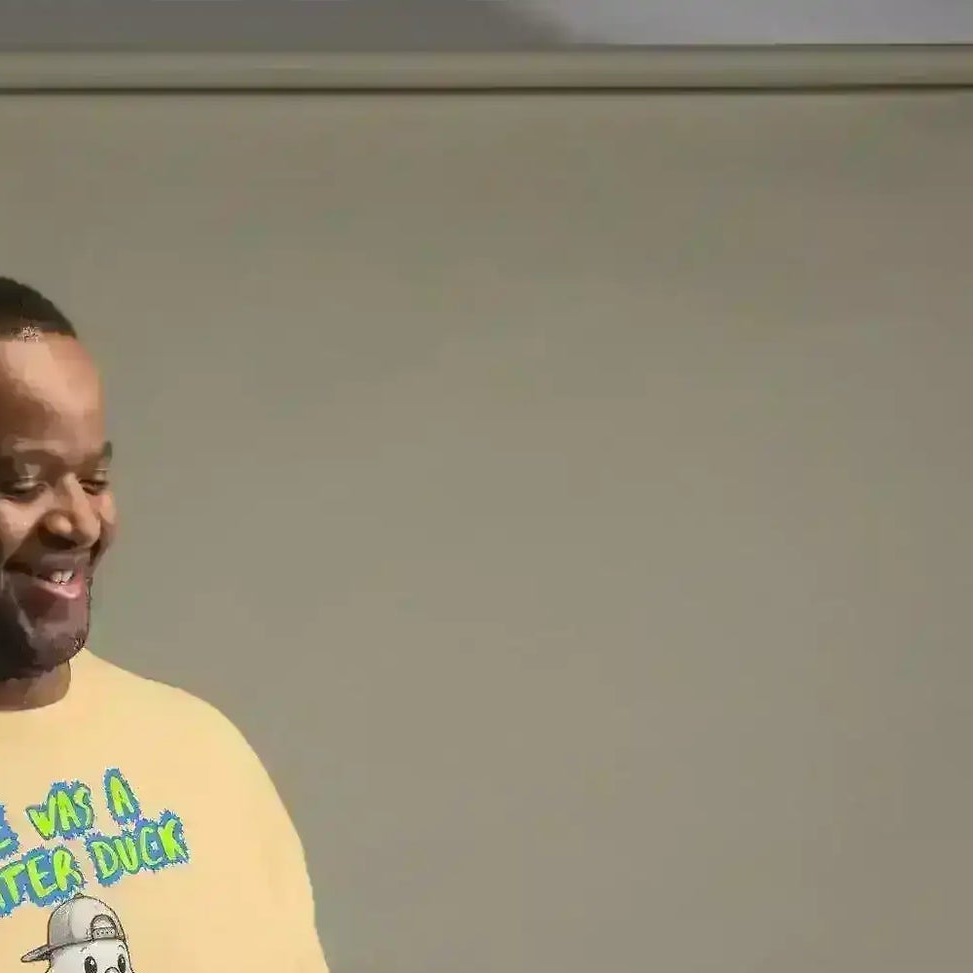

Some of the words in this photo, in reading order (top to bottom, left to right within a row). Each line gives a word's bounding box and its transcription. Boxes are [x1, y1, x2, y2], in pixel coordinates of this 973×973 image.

[27, 784, 94, 839] WAS
[106, 772, 137, 820] A
[89, 815, 188, 883] DUCK
